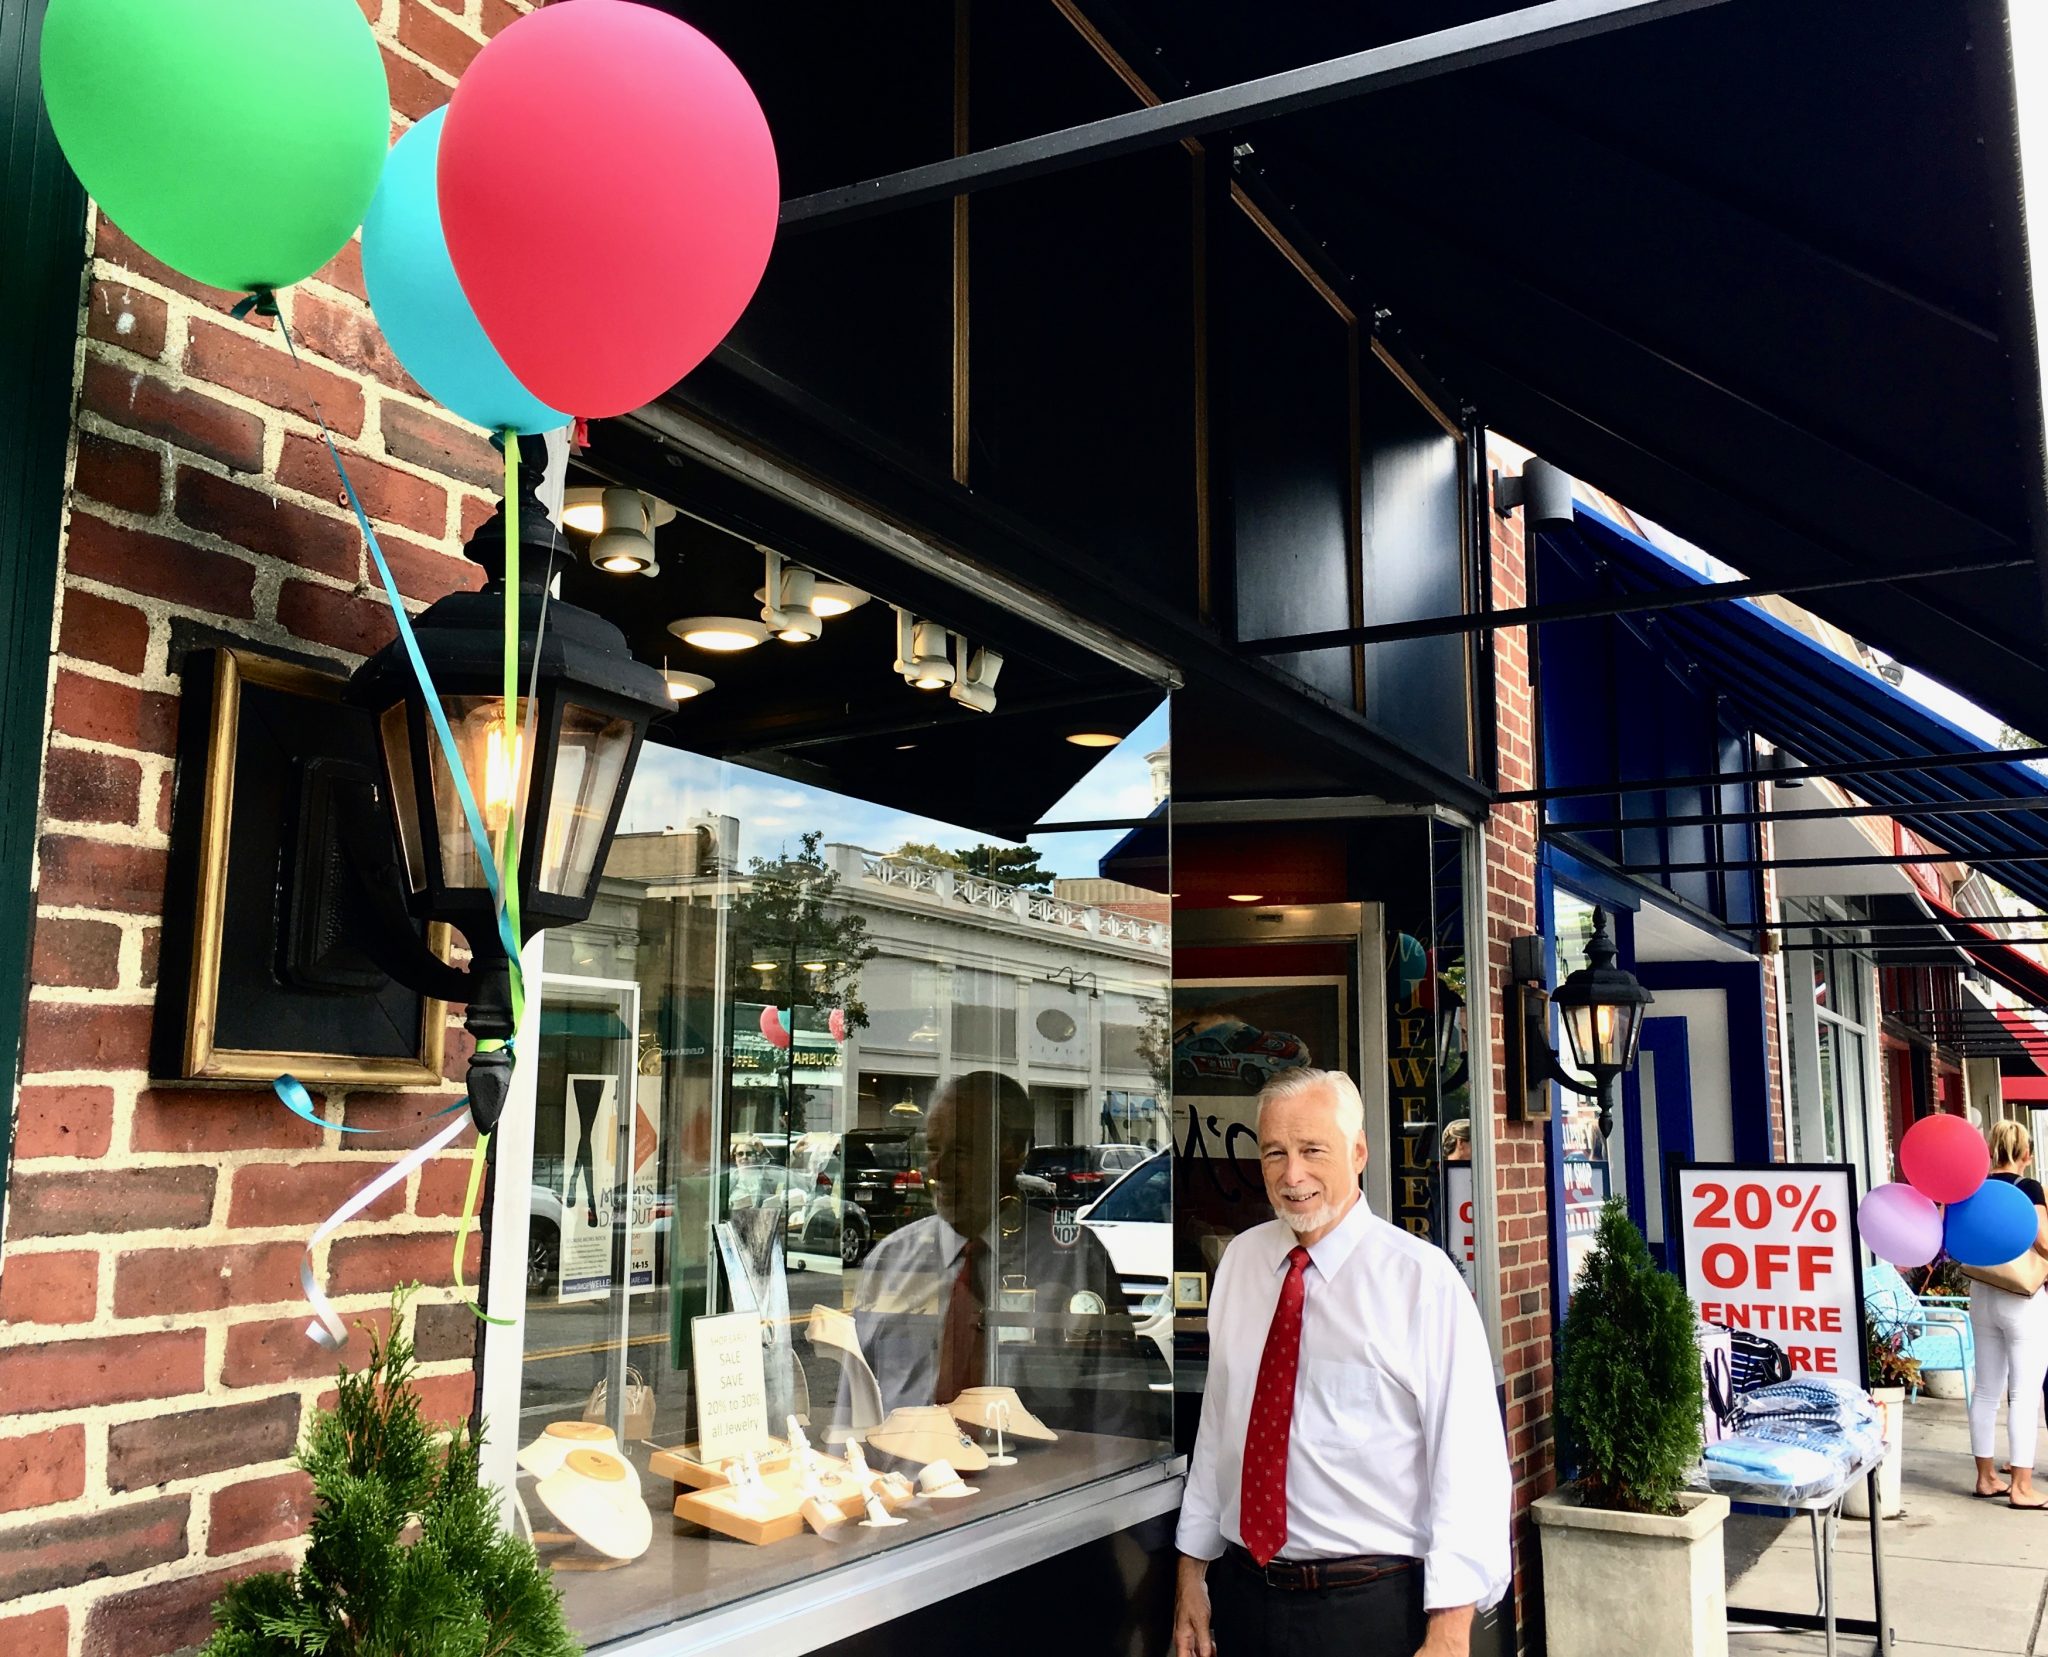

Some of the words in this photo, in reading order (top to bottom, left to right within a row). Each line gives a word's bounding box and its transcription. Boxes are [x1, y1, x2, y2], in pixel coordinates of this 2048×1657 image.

[1692, 1183, 1837, 1233] 20%
[1701, 1243, 1834, 1291] OFF
[1701, 1302, 1842, 1333] ENTIRE
[719, 1350, 741, 1366] SALE
[720, 1373, 744, 1390] SAVE
[707, 1400, 727, 1416] 20%
[729, 1400, 739, 1411] to
[741, 1392, 760, 1409] 30%
